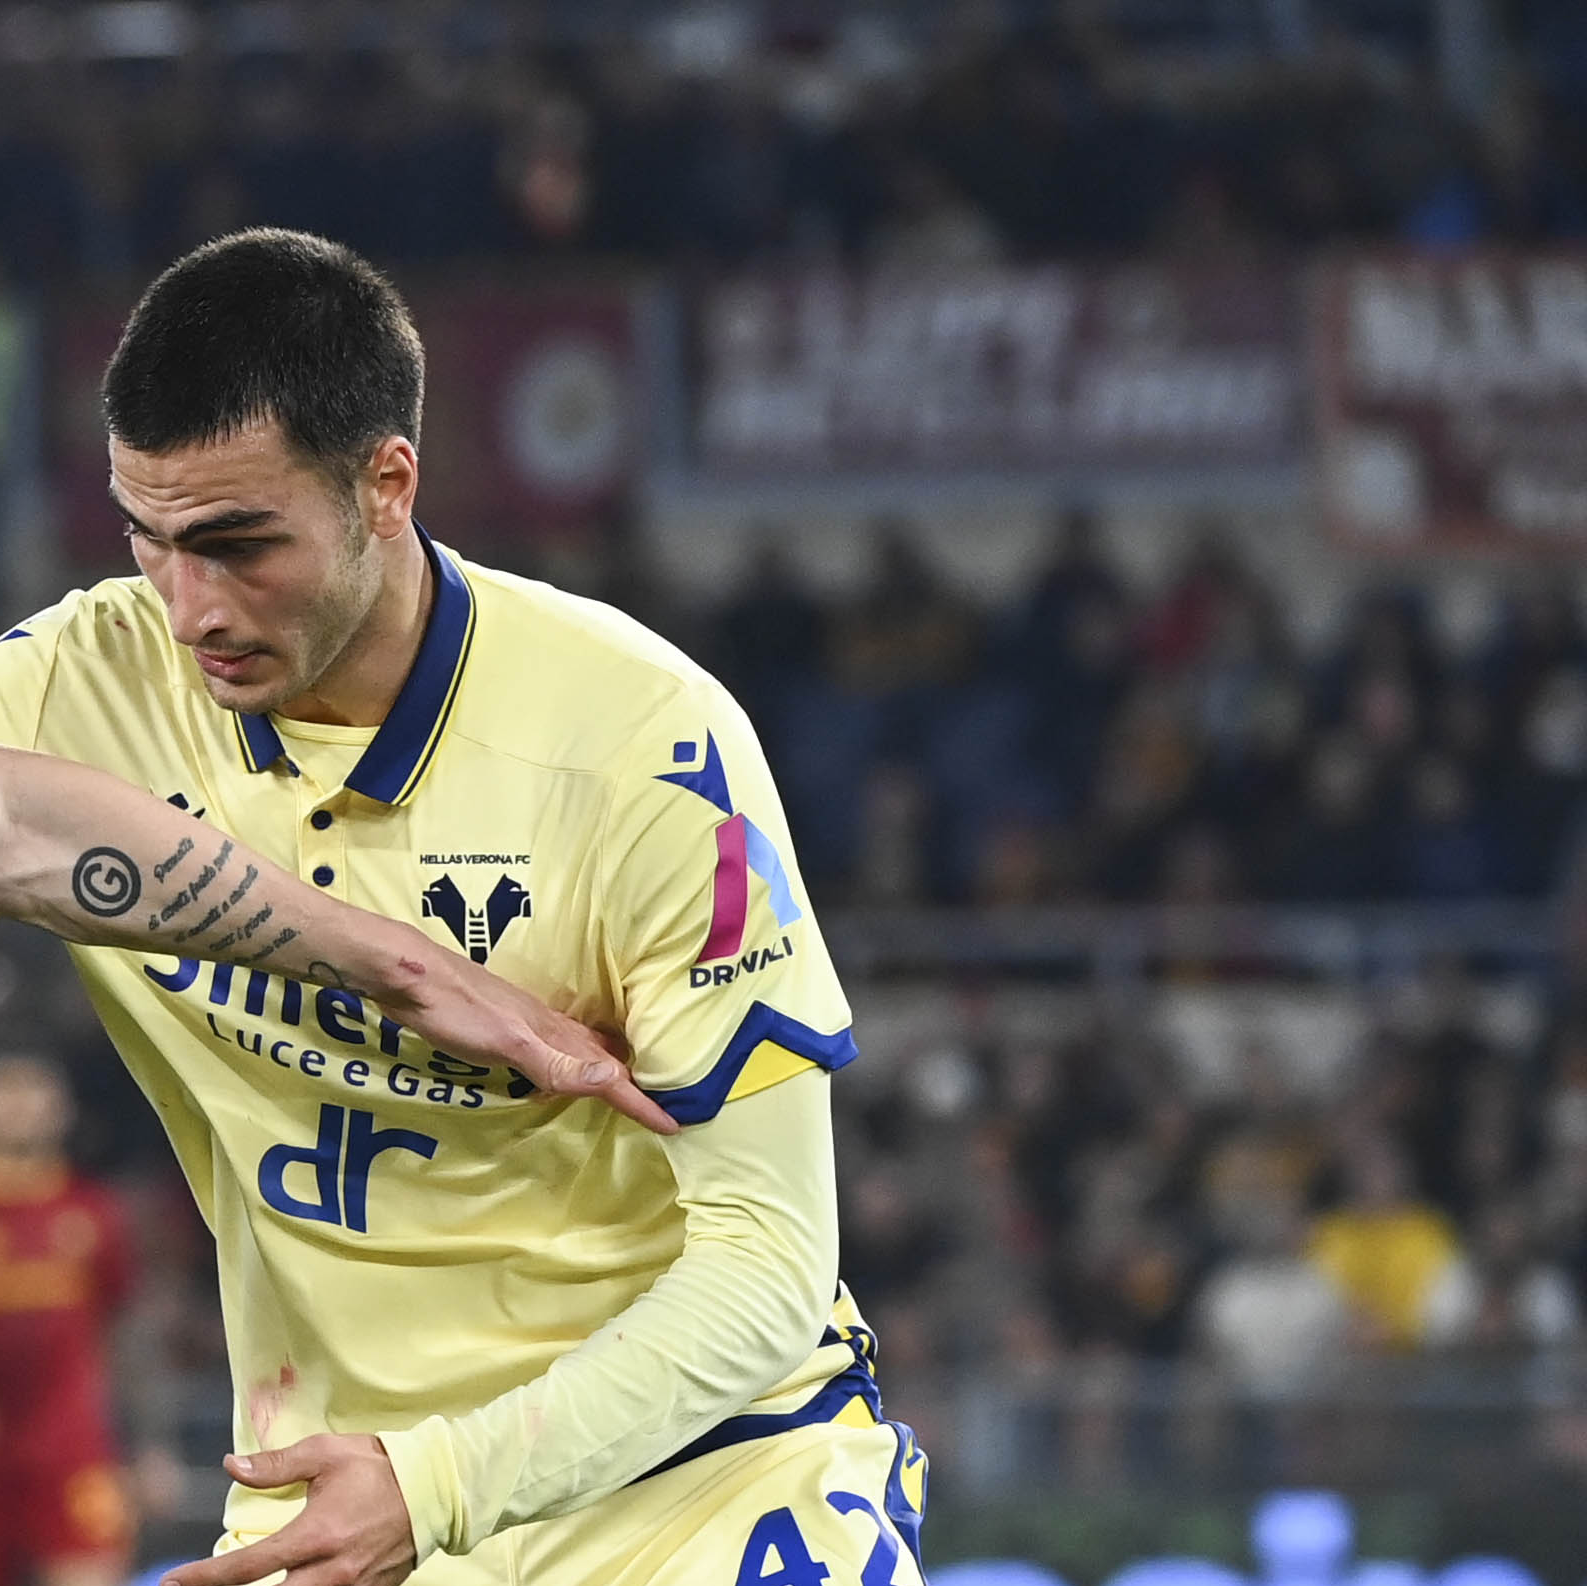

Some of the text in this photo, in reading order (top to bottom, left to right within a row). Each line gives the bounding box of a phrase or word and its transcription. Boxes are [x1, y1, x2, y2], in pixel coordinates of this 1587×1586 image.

[420, 854, 531, 865] HELLAS VERONA FC
[206, 1012, 487, 1109] Luce e Gas
[257, 1102, 439, 1234] dr
